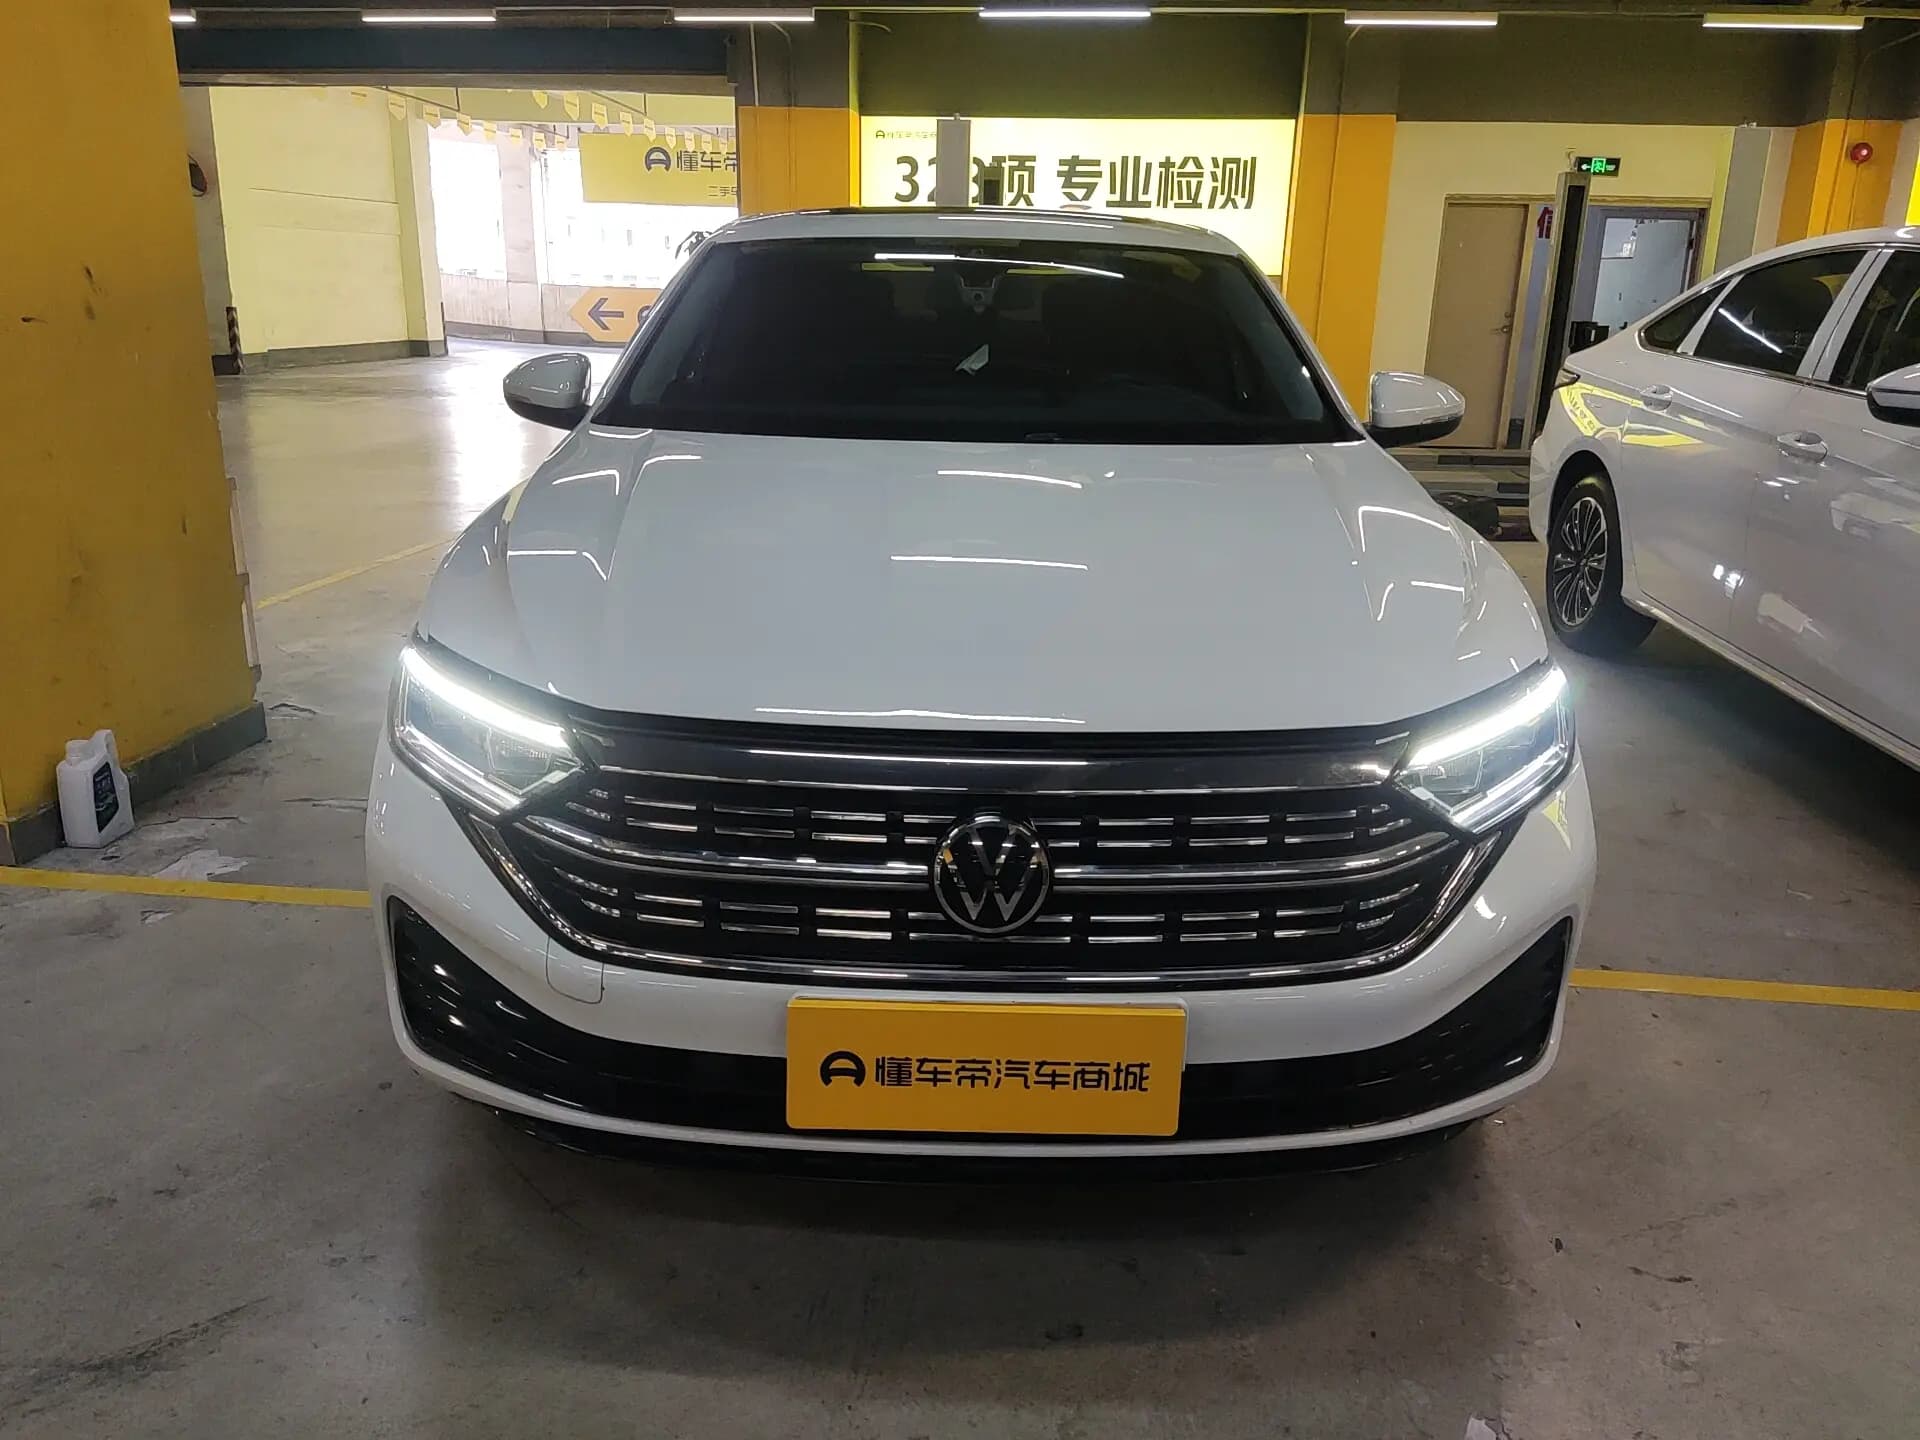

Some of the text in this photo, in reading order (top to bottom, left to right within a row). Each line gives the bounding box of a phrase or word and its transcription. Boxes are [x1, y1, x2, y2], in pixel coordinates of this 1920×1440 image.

[1056, 155, 1257, 210] 专业检测
[874, 1055, 1151, 1093] 懂车帝汽车商城
